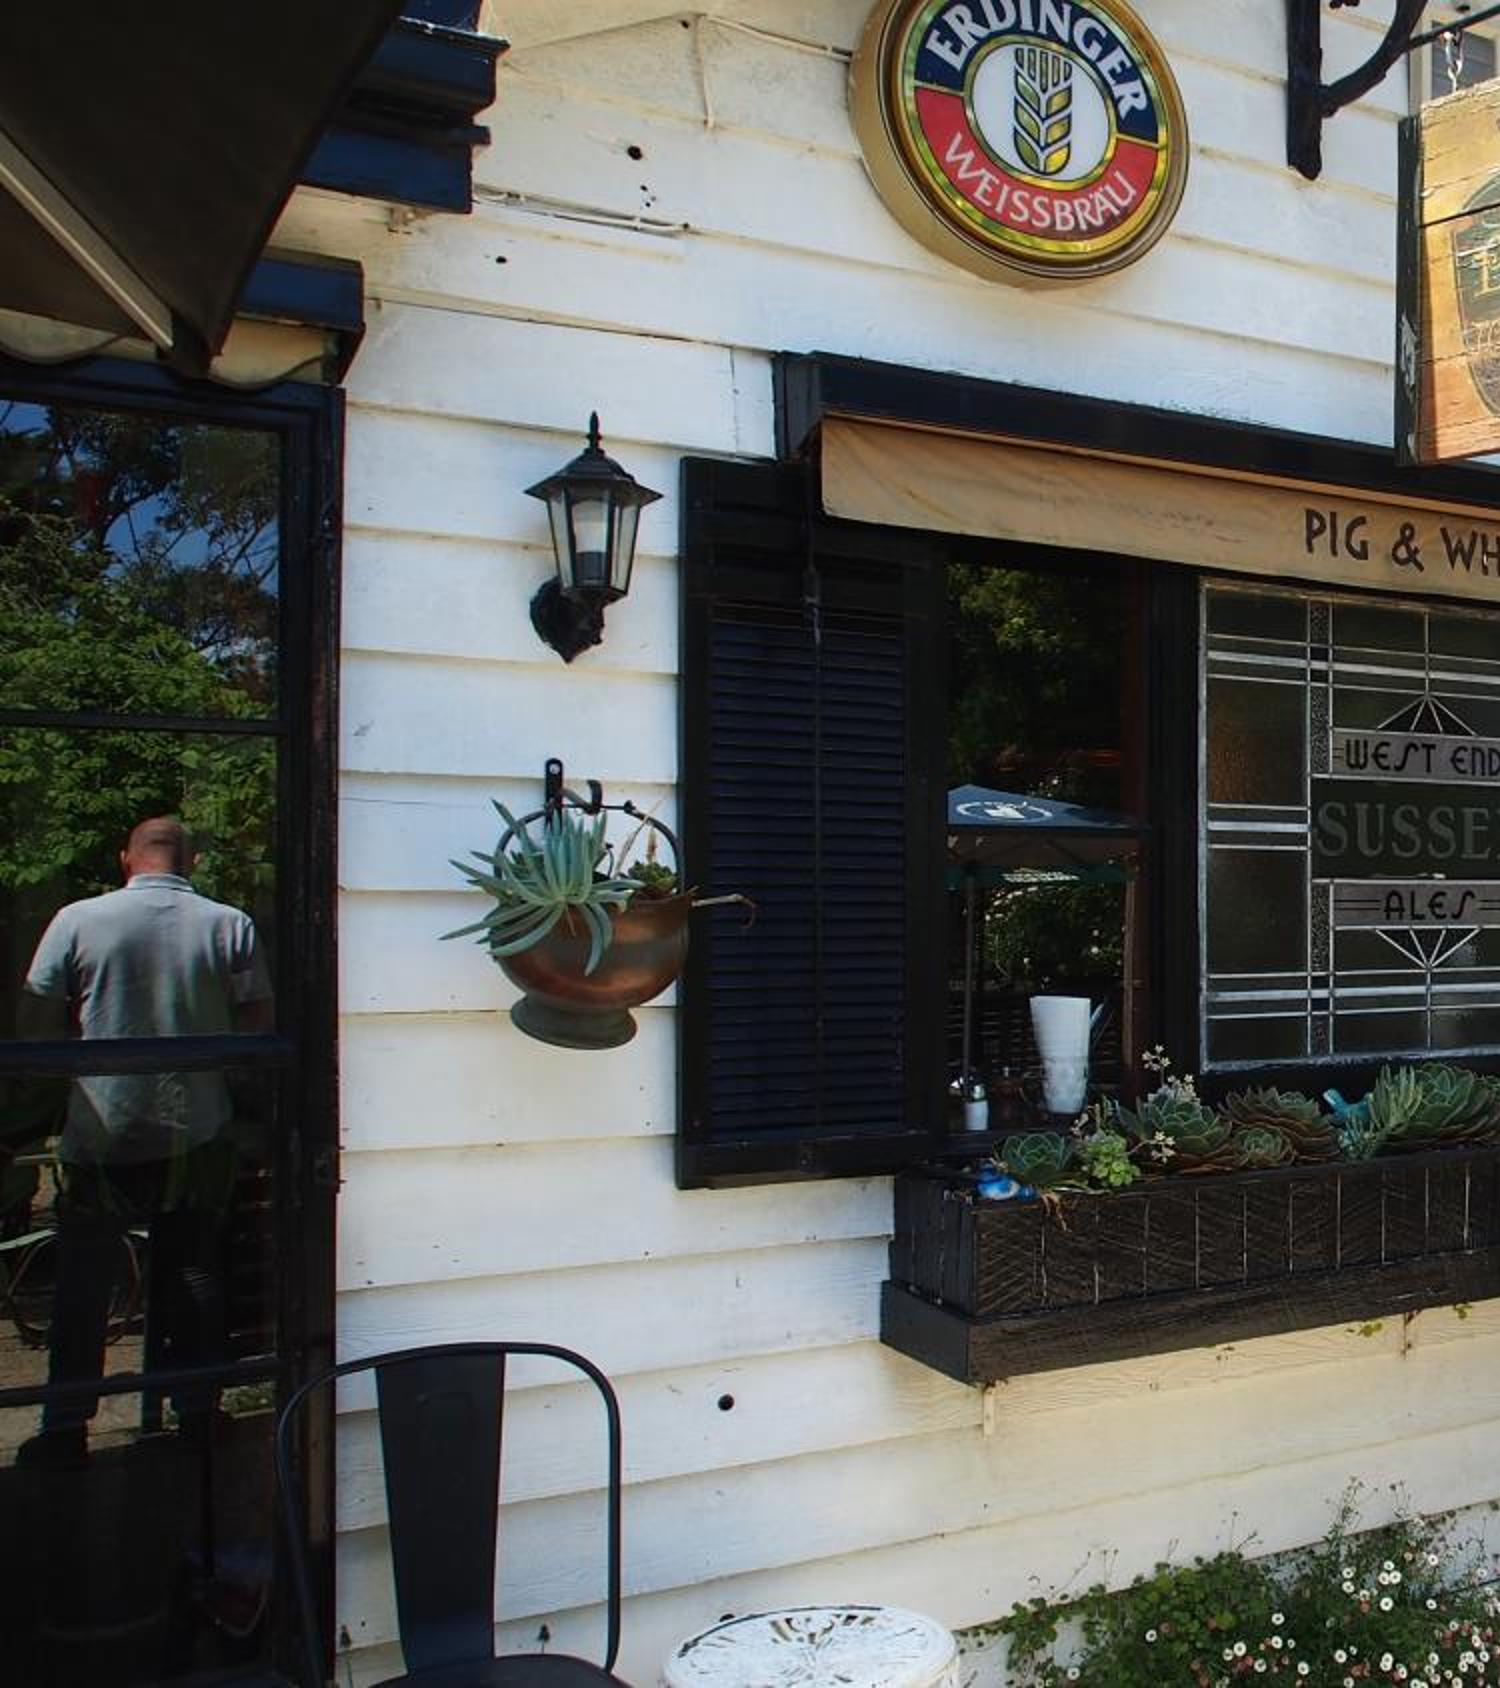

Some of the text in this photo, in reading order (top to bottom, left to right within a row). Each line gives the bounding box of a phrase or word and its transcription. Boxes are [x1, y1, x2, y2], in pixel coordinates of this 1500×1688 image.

[925, 0, 1148, 119] ERDINGER
[944, 132, 1137, 232] WEISSBRÄU
[1305, 508, 1368, 561] PIG
[1391, 522, 1424, 572] &
[1345, 740, 1436, 773] WEST
[1384, 890, 1476, 920] ALES
